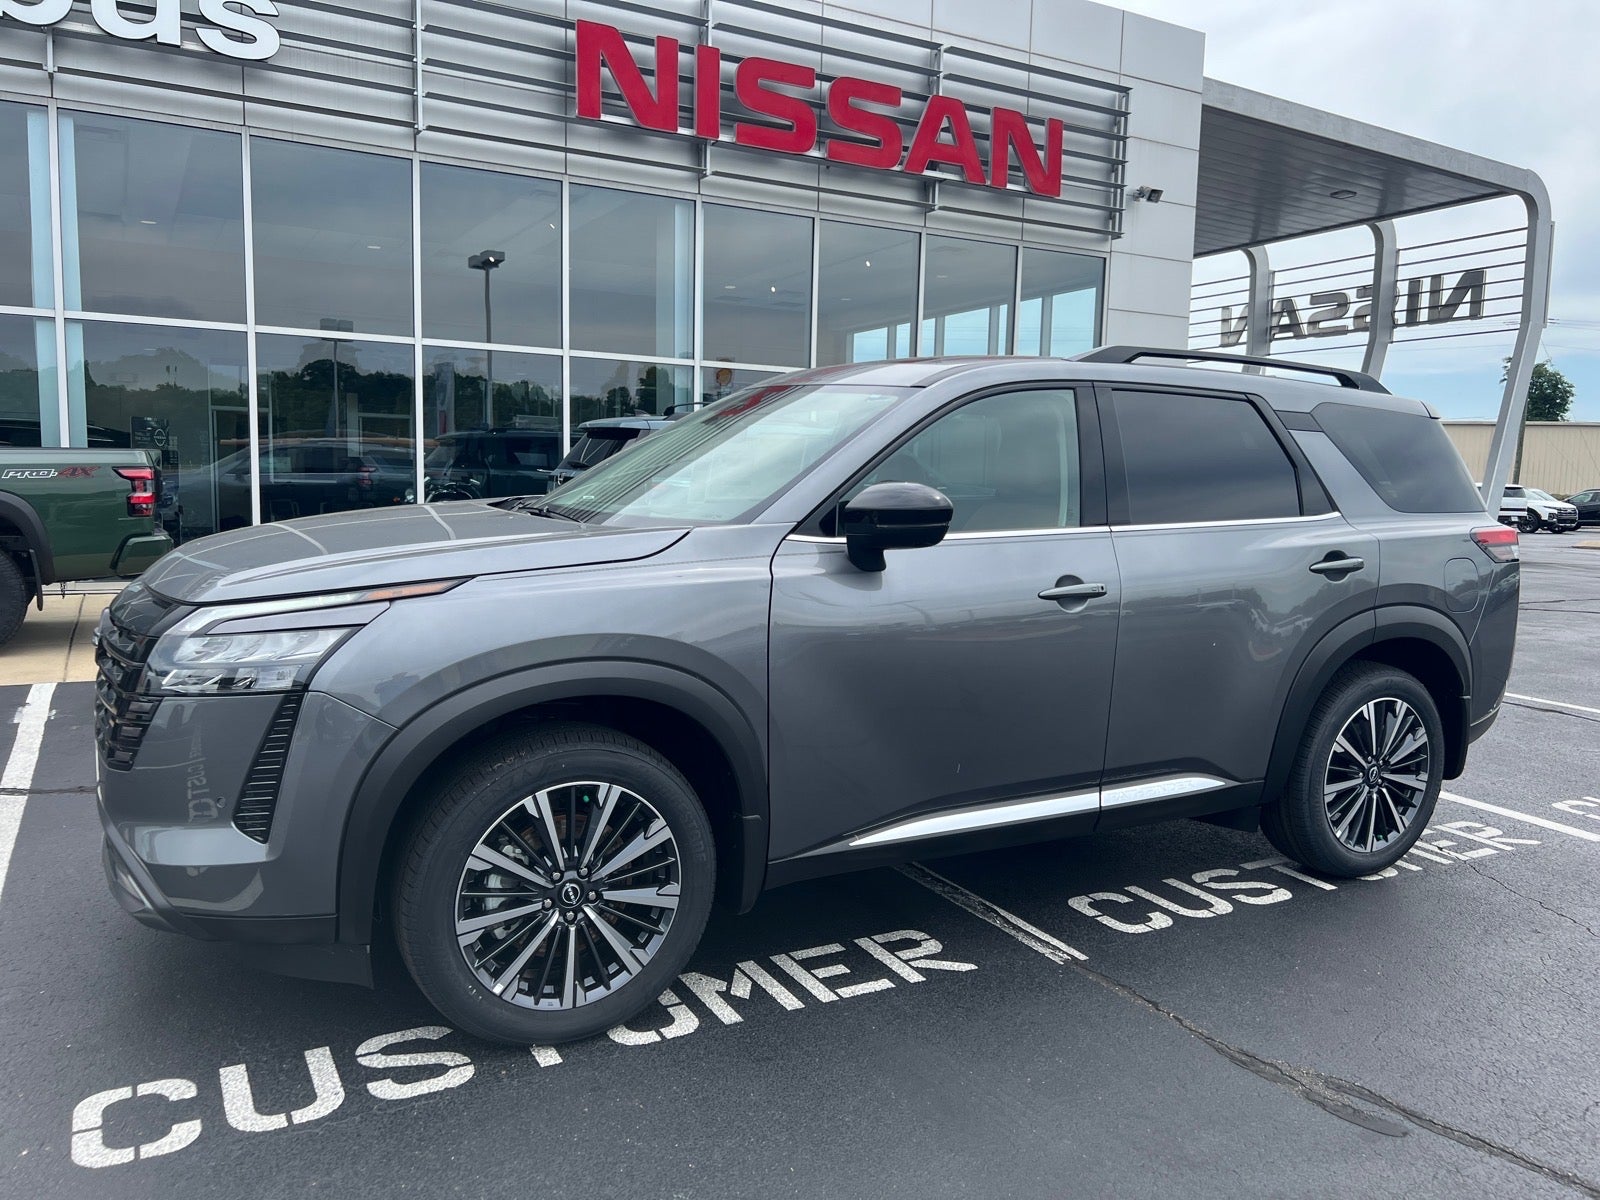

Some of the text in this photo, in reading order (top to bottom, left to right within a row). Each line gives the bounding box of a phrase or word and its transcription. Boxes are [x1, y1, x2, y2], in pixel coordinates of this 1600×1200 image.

[0, 0, 281, 60] us
[575, 19, 1064, 198] NISSAN
[1068, 821, 1542, 934] CUSTER
[71, 929, 978, 1169] CUSOMER
